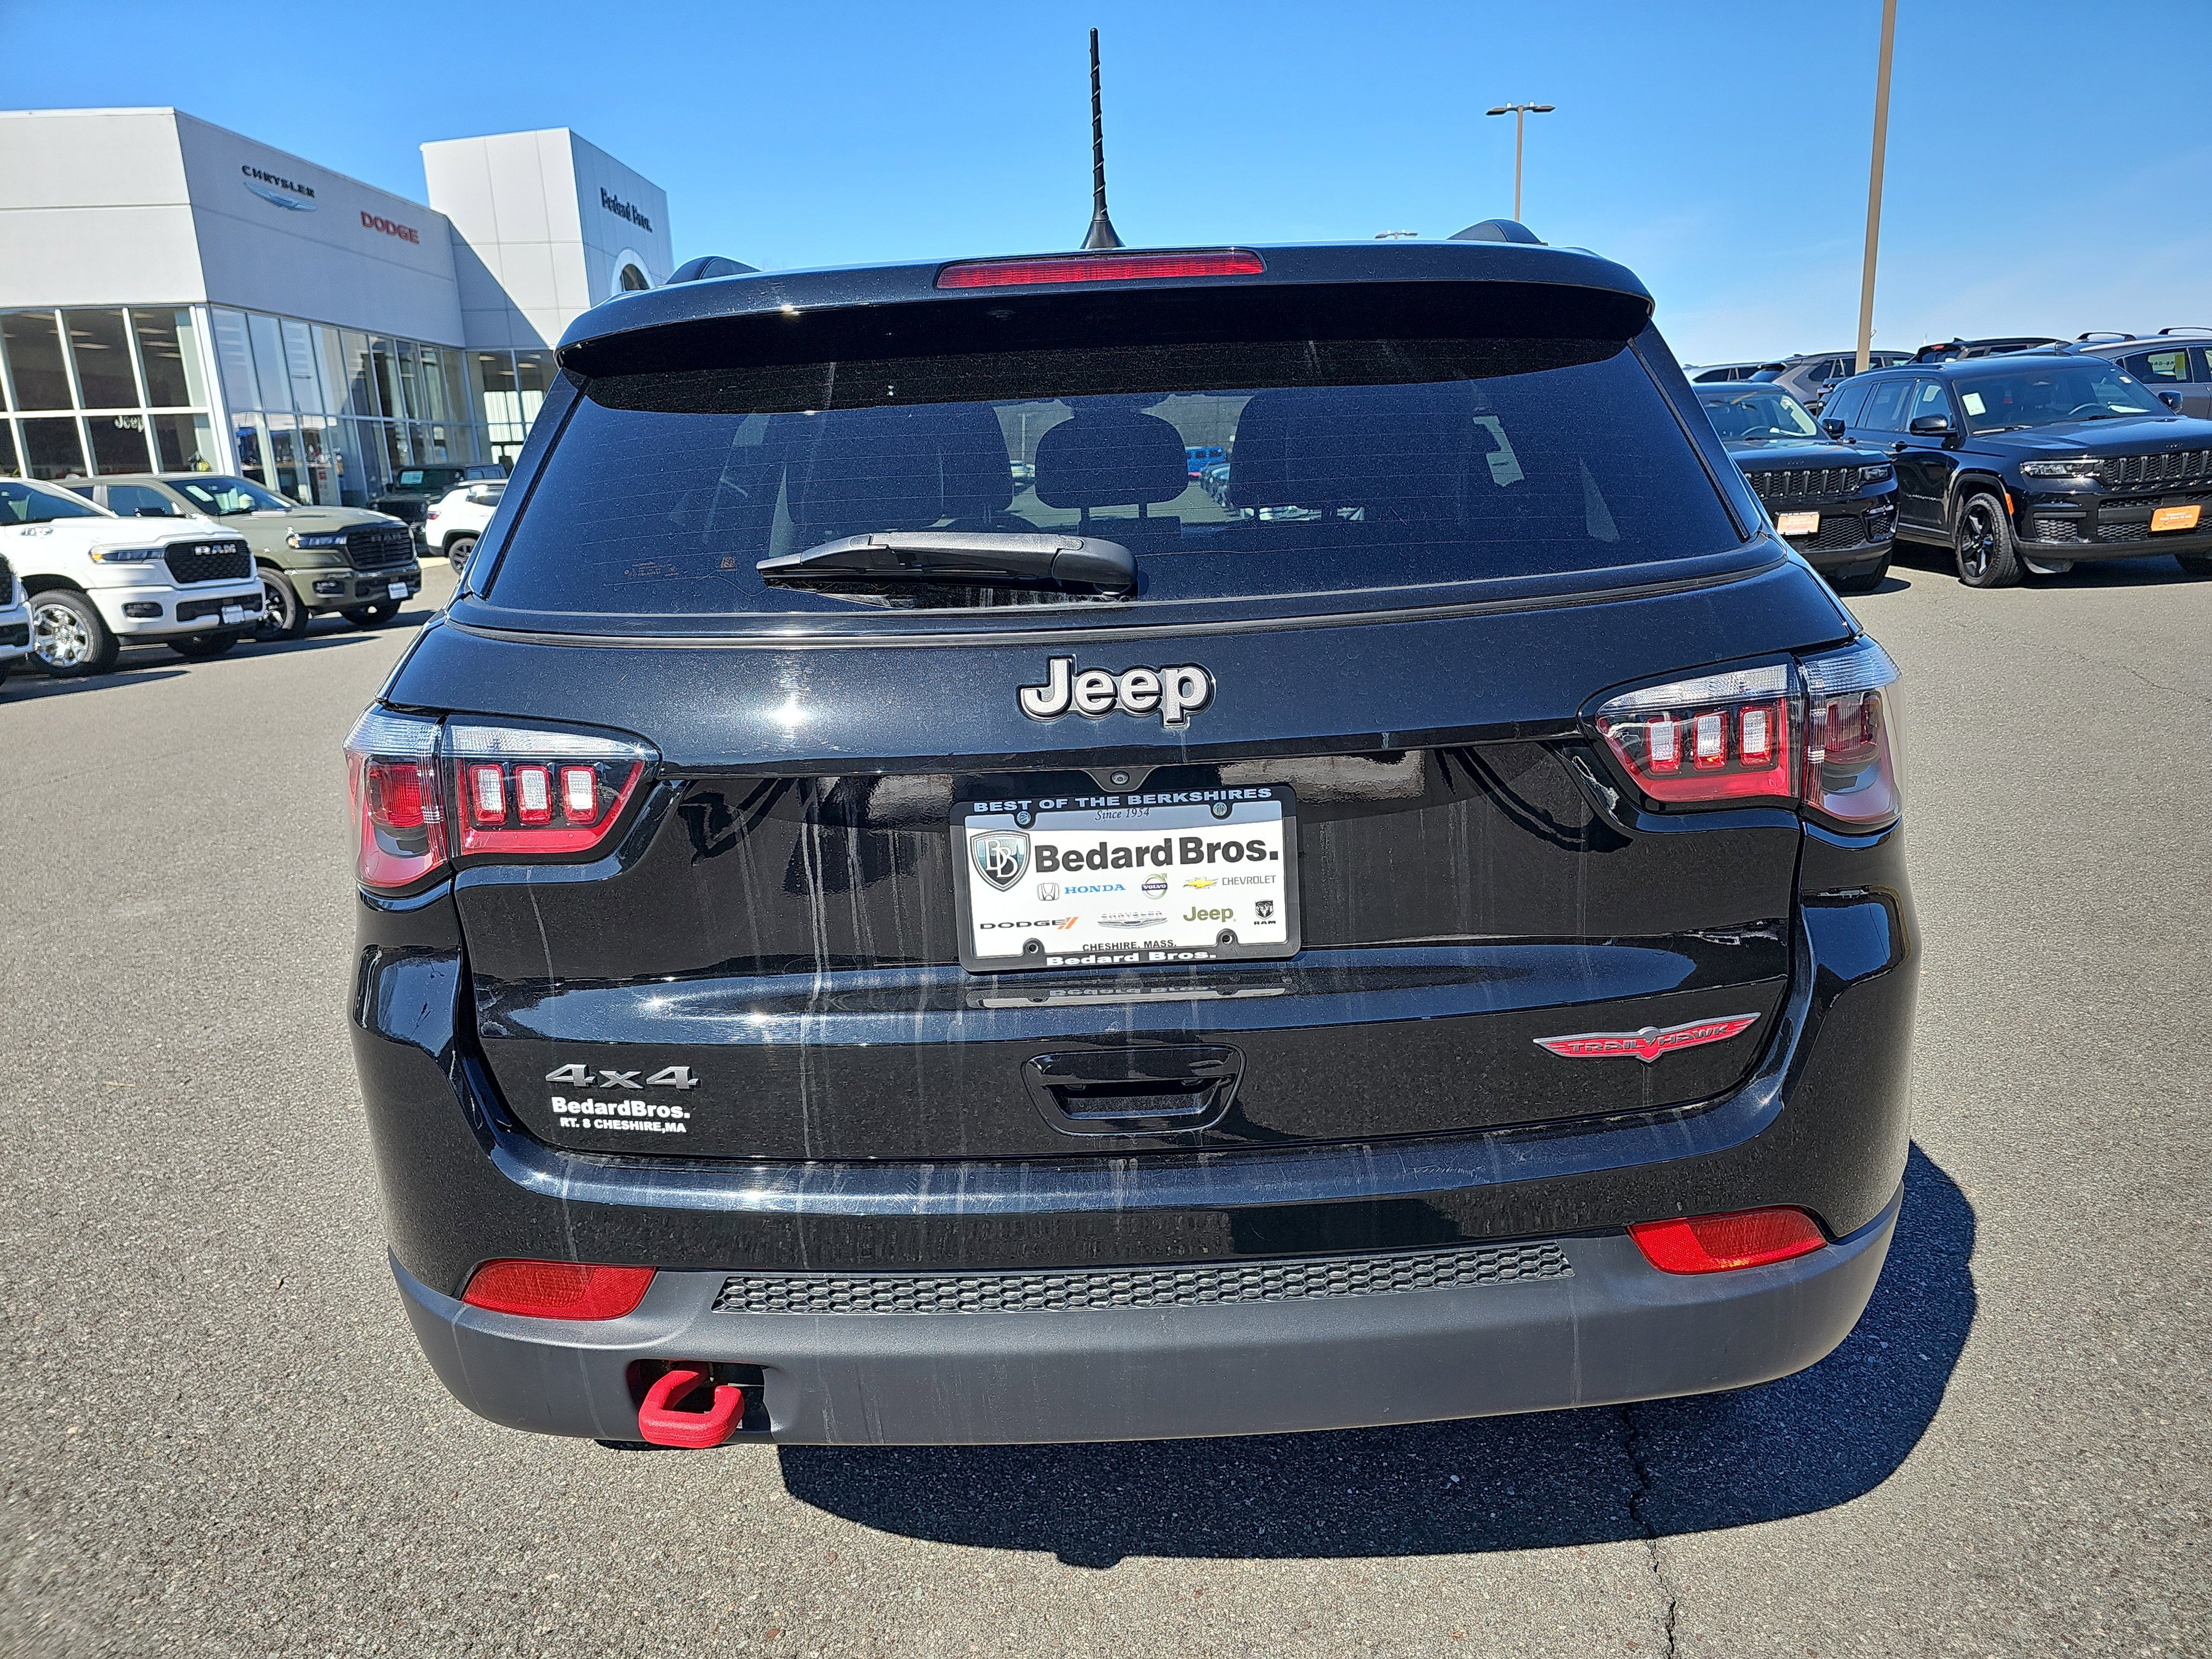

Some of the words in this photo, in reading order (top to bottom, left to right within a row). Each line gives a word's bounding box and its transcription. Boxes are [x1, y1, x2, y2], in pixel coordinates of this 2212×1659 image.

[241, 165, 316, 198] CHRYSLER
[361, 210, 420, 245] DODGE
[195, 544, 236, 556] RAM
[1019, 657, 1210, 725] Jeep
[974, 800, 1032, 813] BEST
[1039, 798, 1068, 809] OF
[1075, 796, 1120, 807] THE
[1128, 788, 1272, 805] BERKSHIRES
[1095, 810, 1122, 821] Since
[1125, 807, 1150, 819] 1954
[1034, 838, 1173, 873] Bedard
[1179, 837, 1278, 865] Bros.
[1222, 874, 1277, 886] CHEVROLET
[1064, 884, 1126, 894] HONDA
[1183, 906, 1233, 923] Jeep
[980, 919, 1067, 929] DODGE
[1144, 940, 1177, 949] MASS.
[1046, 953, 1140, 966] Bedard
[1148, 951, 1217, 961] Bros.
[545, 1063, 701, 1090] 4x4
[560, 1117, 580, 1128] RT.
[582, 1118, 591, 1128] 8
